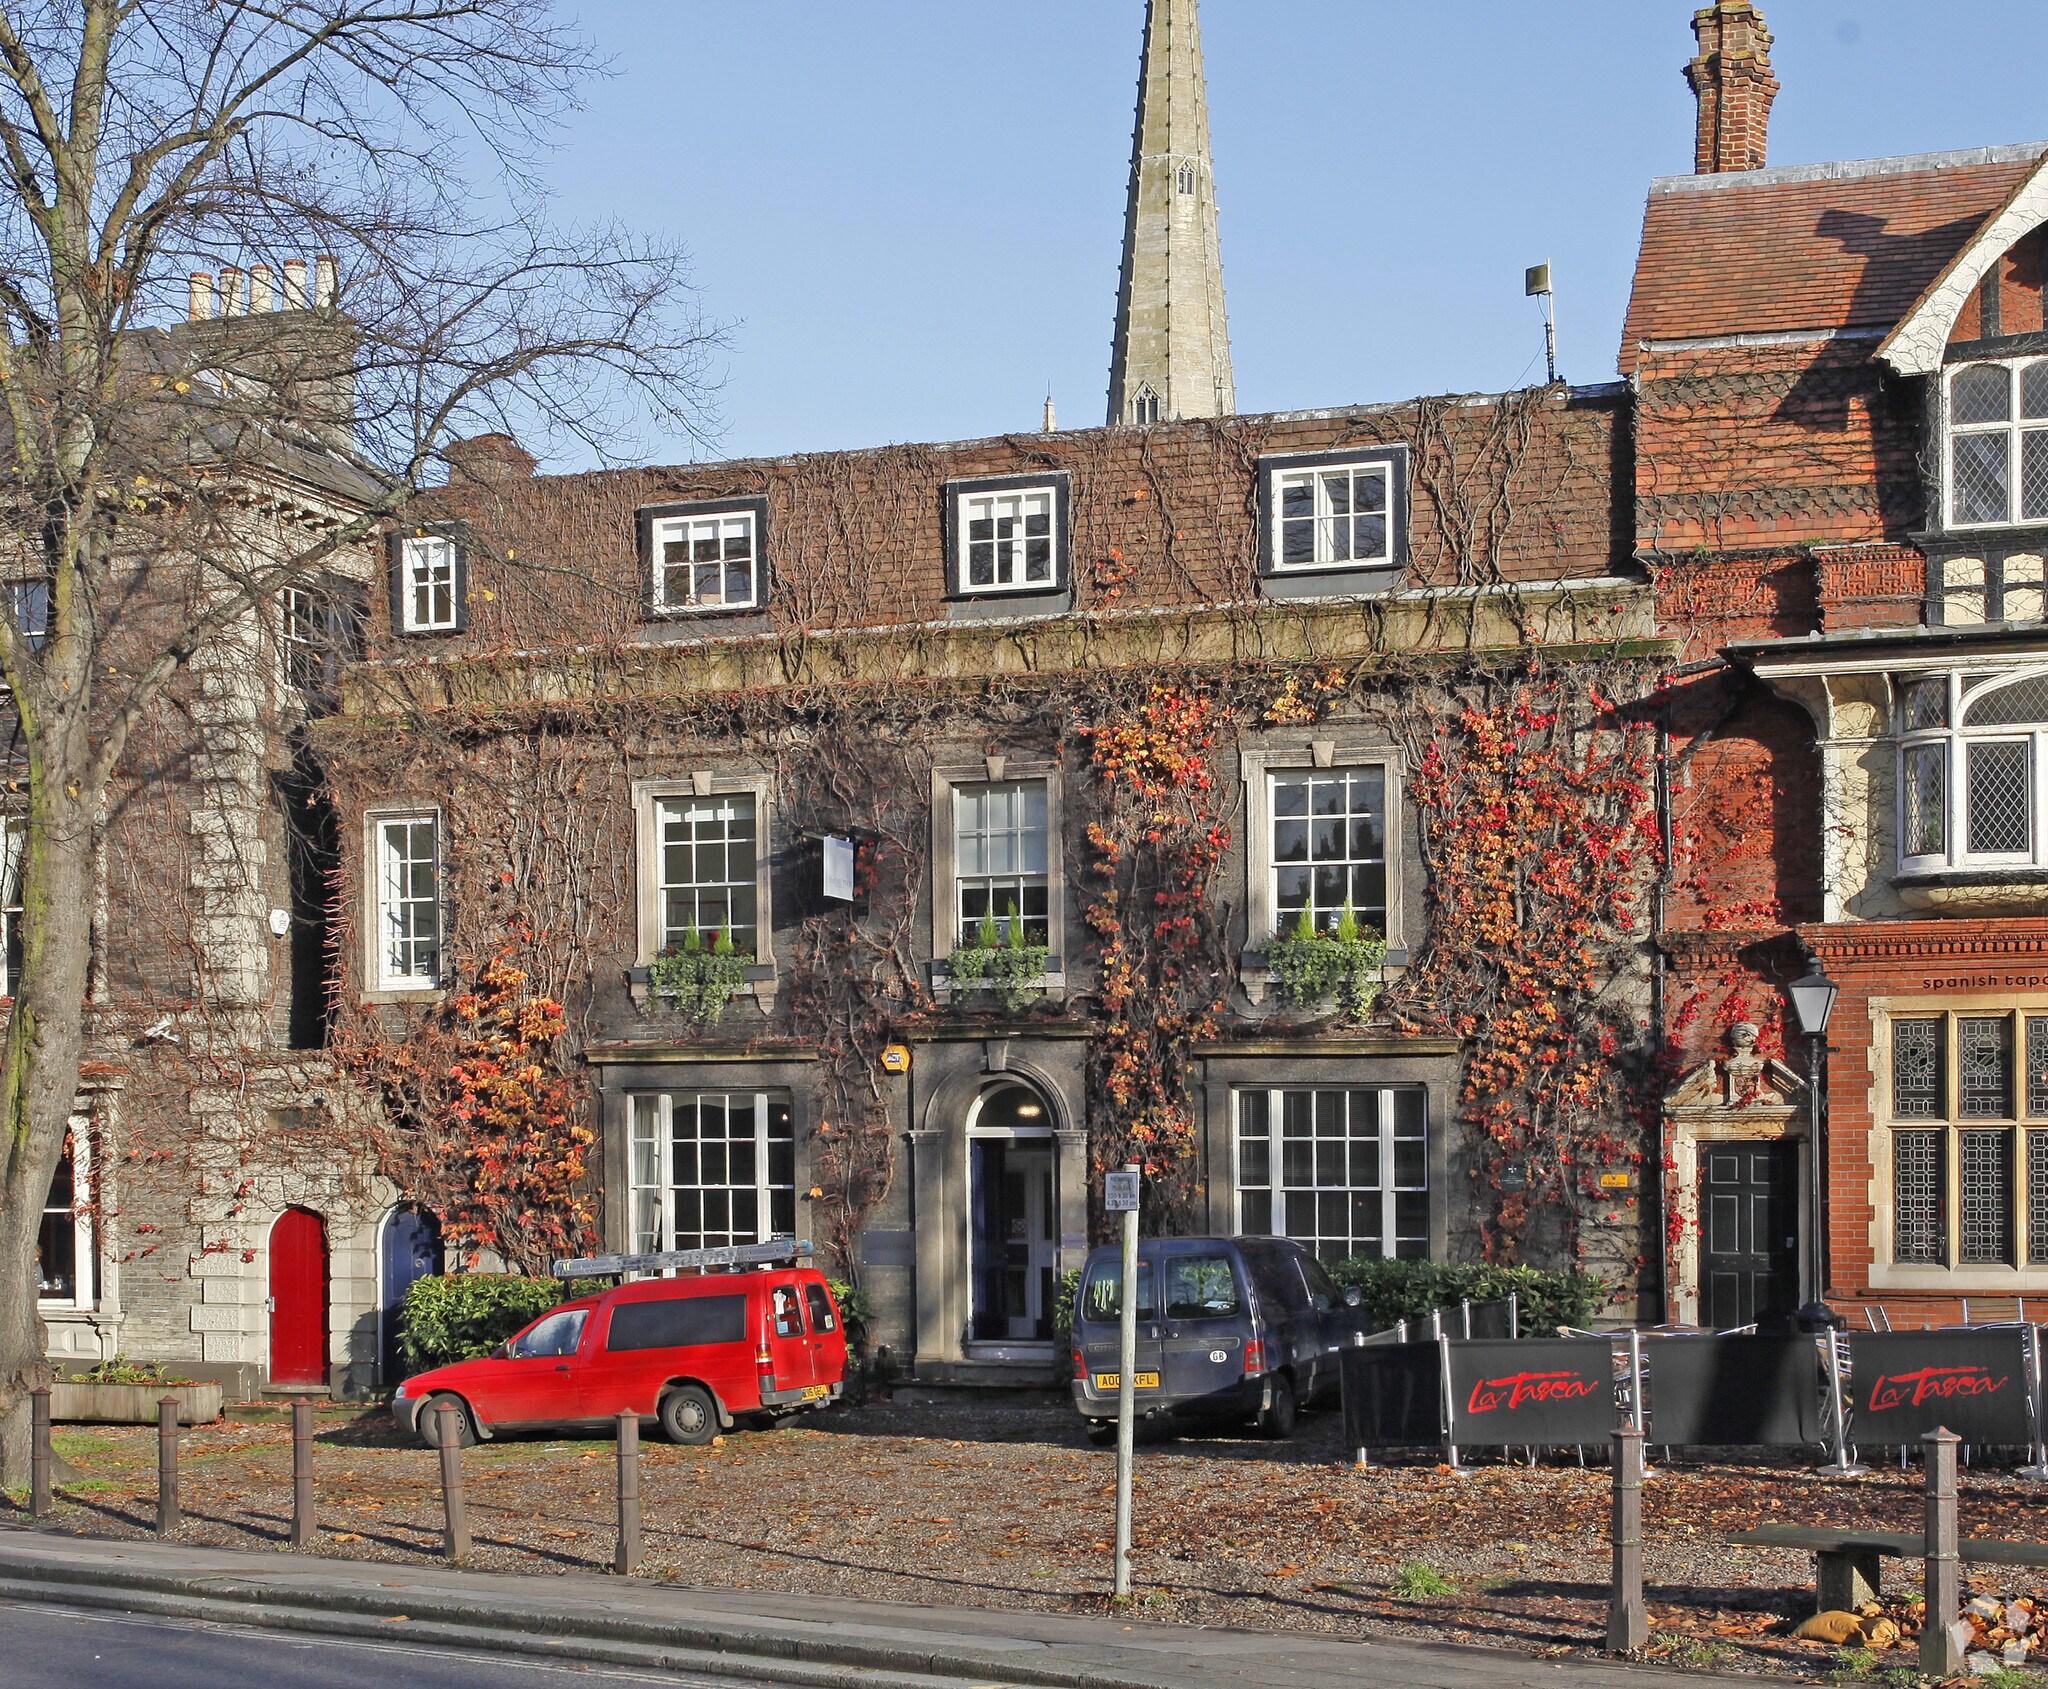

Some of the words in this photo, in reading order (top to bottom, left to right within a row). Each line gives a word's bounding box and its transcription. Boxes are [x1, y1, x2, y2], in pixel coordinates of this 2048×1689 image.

[1923, 974, 1998, 991] spanish
[1212, 1351, 1224, 1361] GB
[1468, 1378, 1508, 1414] La
[1486, 1371, 1599, 1410] Tasca
[1869, 1374, 1911, 1412] La
[1887, 1366, 2010, 1407] Tasca
